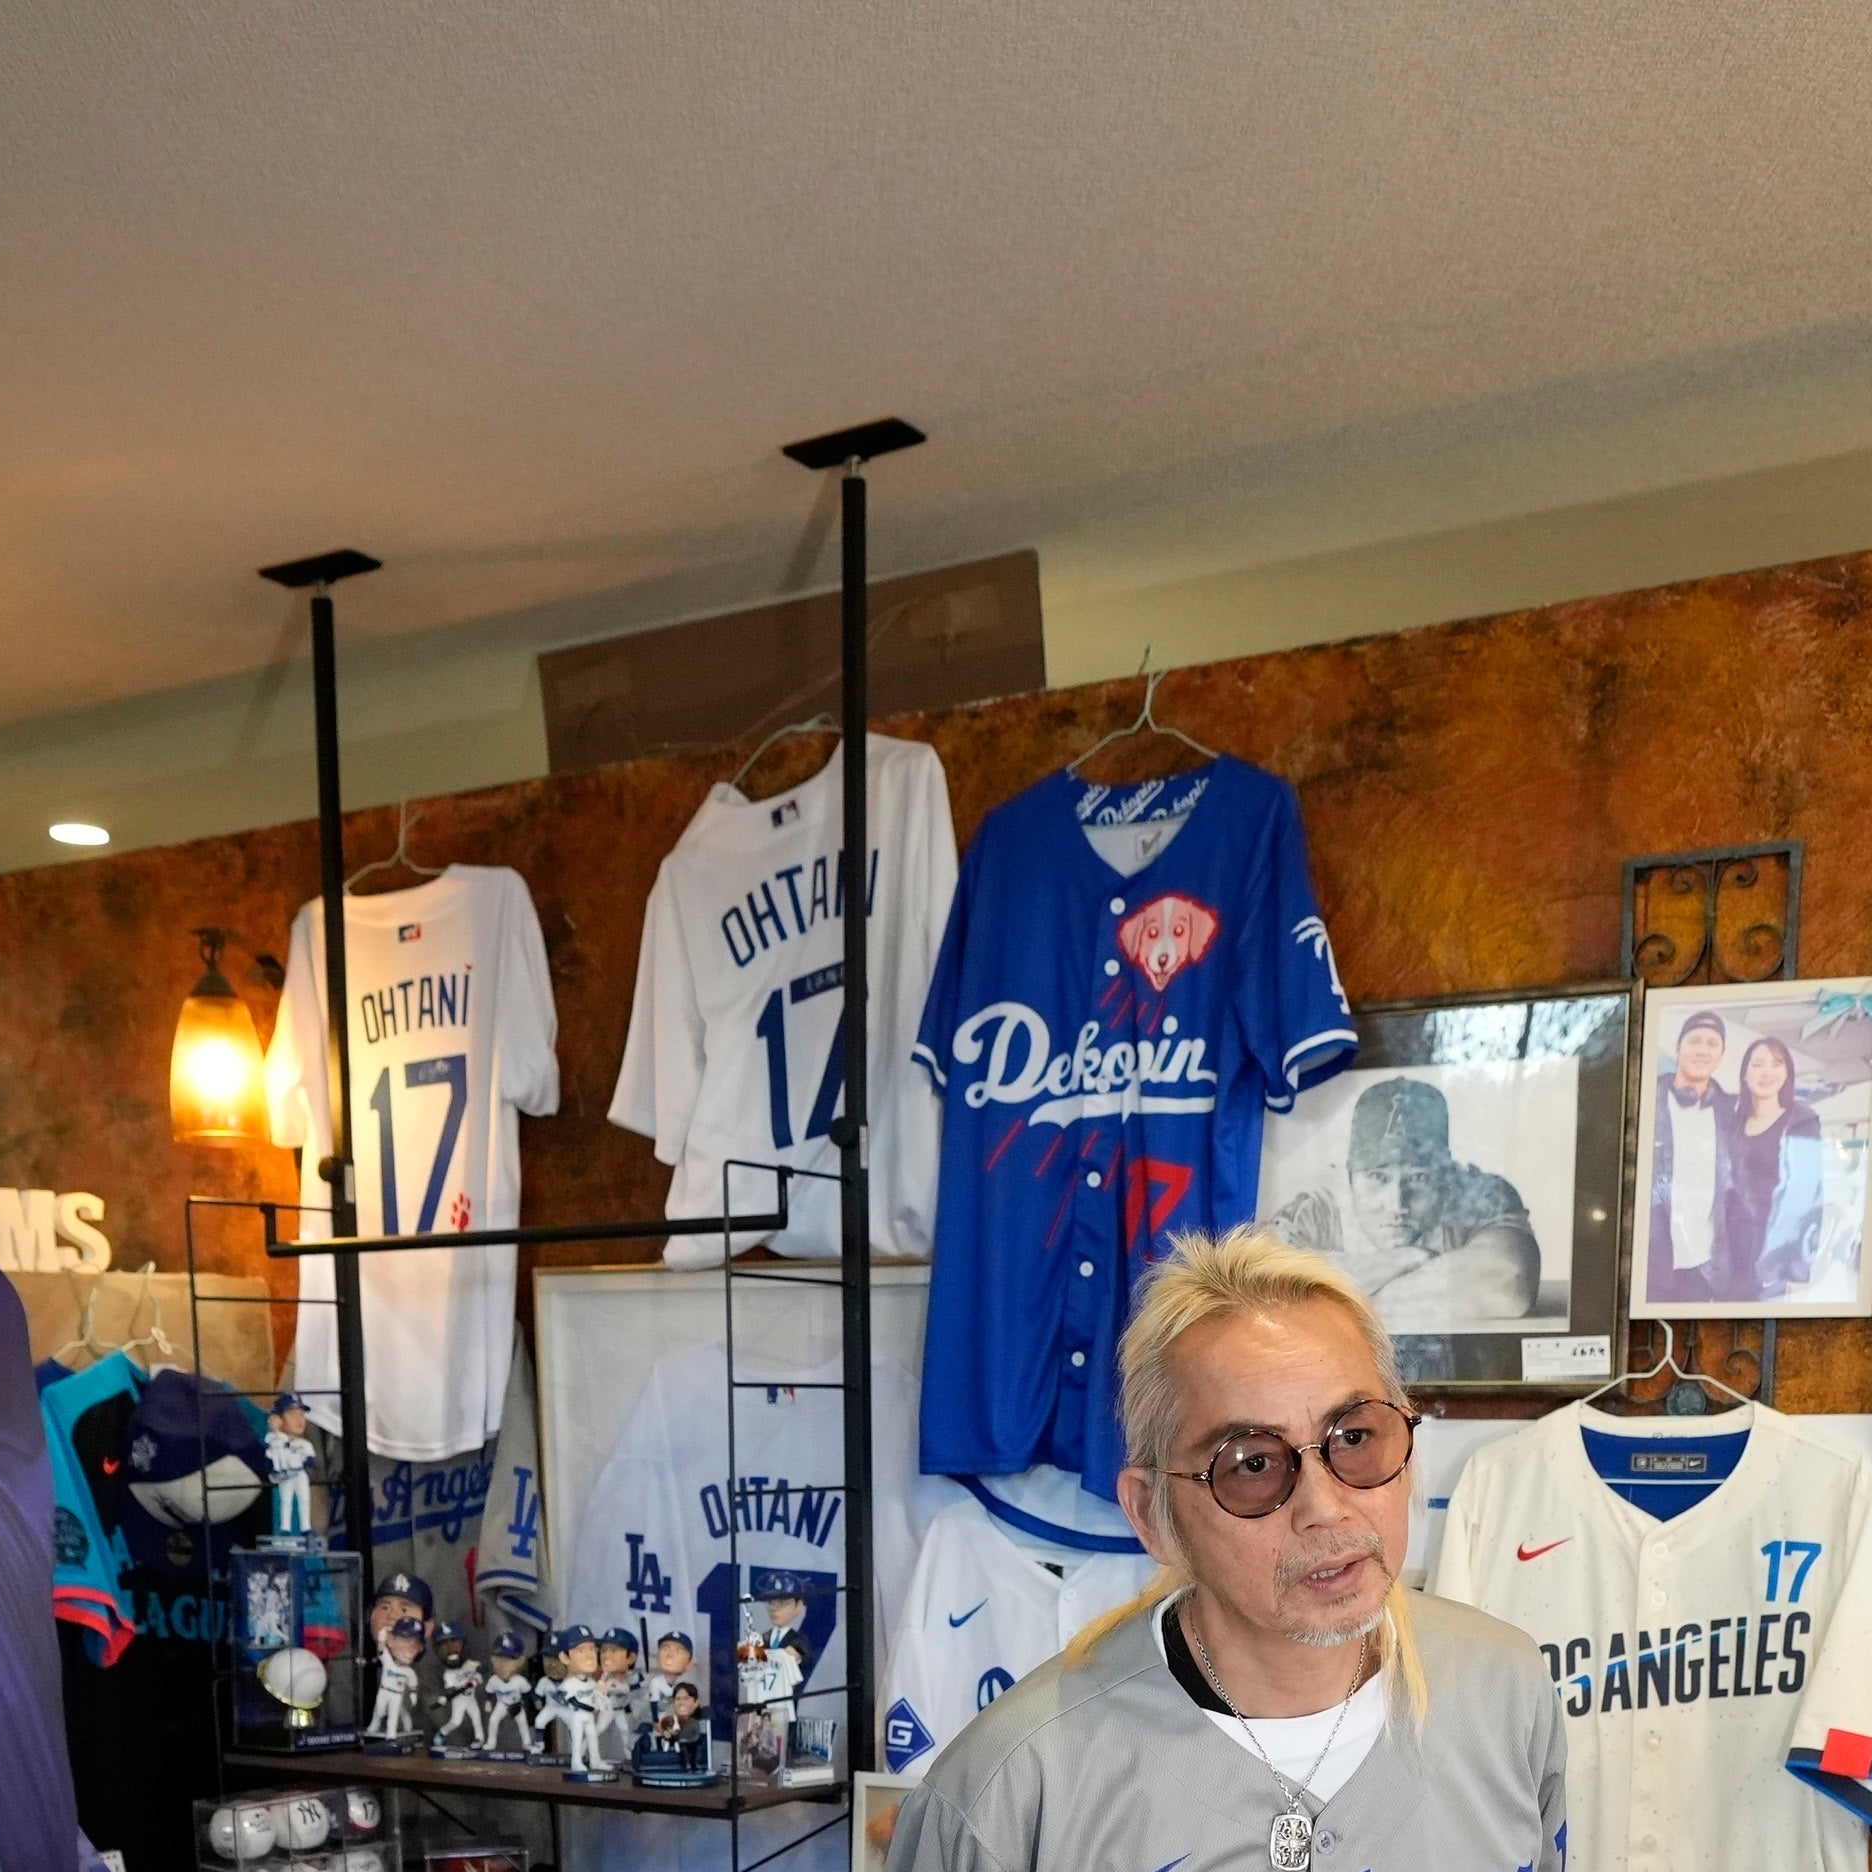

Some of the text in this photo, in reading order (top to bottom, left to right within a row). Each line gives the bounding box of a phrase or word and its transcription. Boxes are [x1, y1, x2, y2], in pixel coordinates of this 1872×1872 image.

[360, 972, 472, 1047] OHTANI
[951, 1001, 1219, 1131] Dekopin
[368, 1053, 472, 1240] 17
[701, 1473, 843, 1549] OHTANI
[623, 1533, 672, 1614] LA
[1761, 1538, 1825, 1604] 17
[1598, 1610, 1814, 1712] ANGELES
